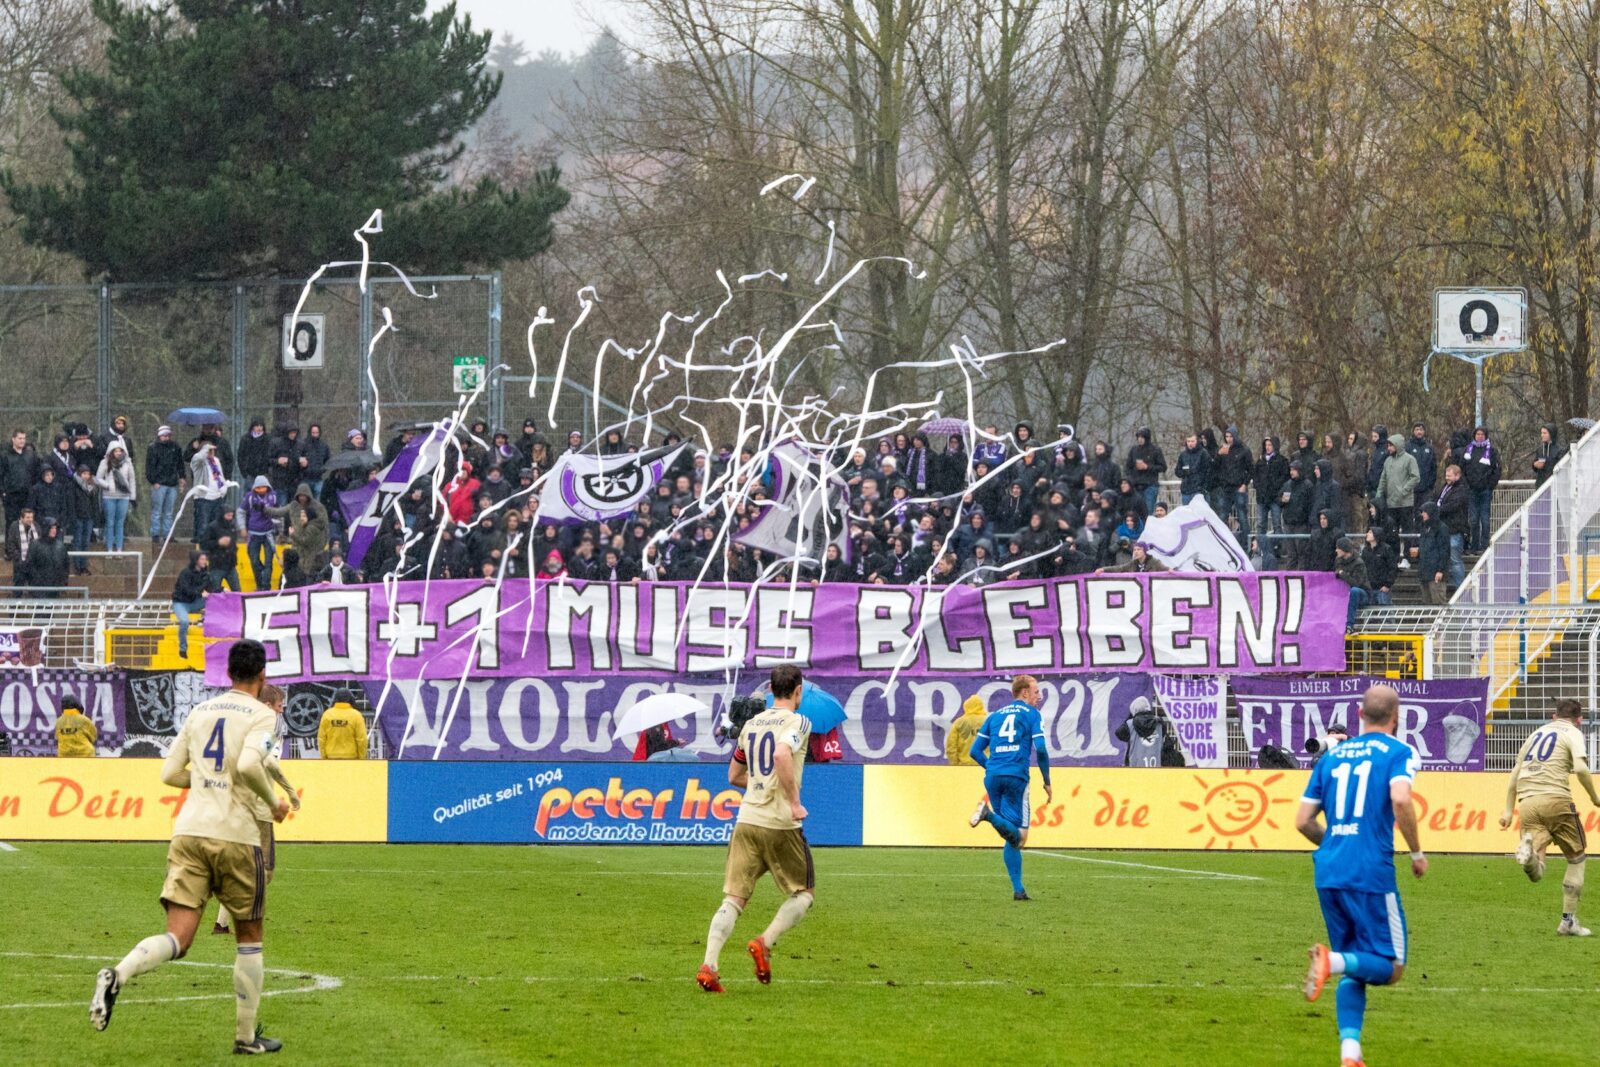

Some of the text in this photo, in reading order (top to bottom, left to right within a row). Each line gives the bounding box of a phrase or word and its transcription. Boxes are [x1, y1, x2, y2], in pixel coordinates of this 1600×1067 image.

[242, 576, 1306, 678] 50+1 MUSS BLEIBEN!
[1290, 680, 1331, 694] EIMER
[1340, 678, 1361, 692] IST
[842, 678, 1120, 758] CRW
[998, 714, 1017, 743] 4
[1239, 701, 1433, 757] EIMR
[203, 717, 226, 772] 4
[747, 730, 776, 777] 10
[824, 740, 842, 753] 42
[1189, 742, 1218, 760] ION
[1523, 731, 1558, 762] 20
[38, 777, 145, 818] Dein
[433, 768, 564, 823] Qualität seit 1994
[534, 777, 674, 838] peter
[1094, 790, 1149, 828] die
[1331, 760, 1373, 820] 11
[548, 822, 648, 842] modernste
